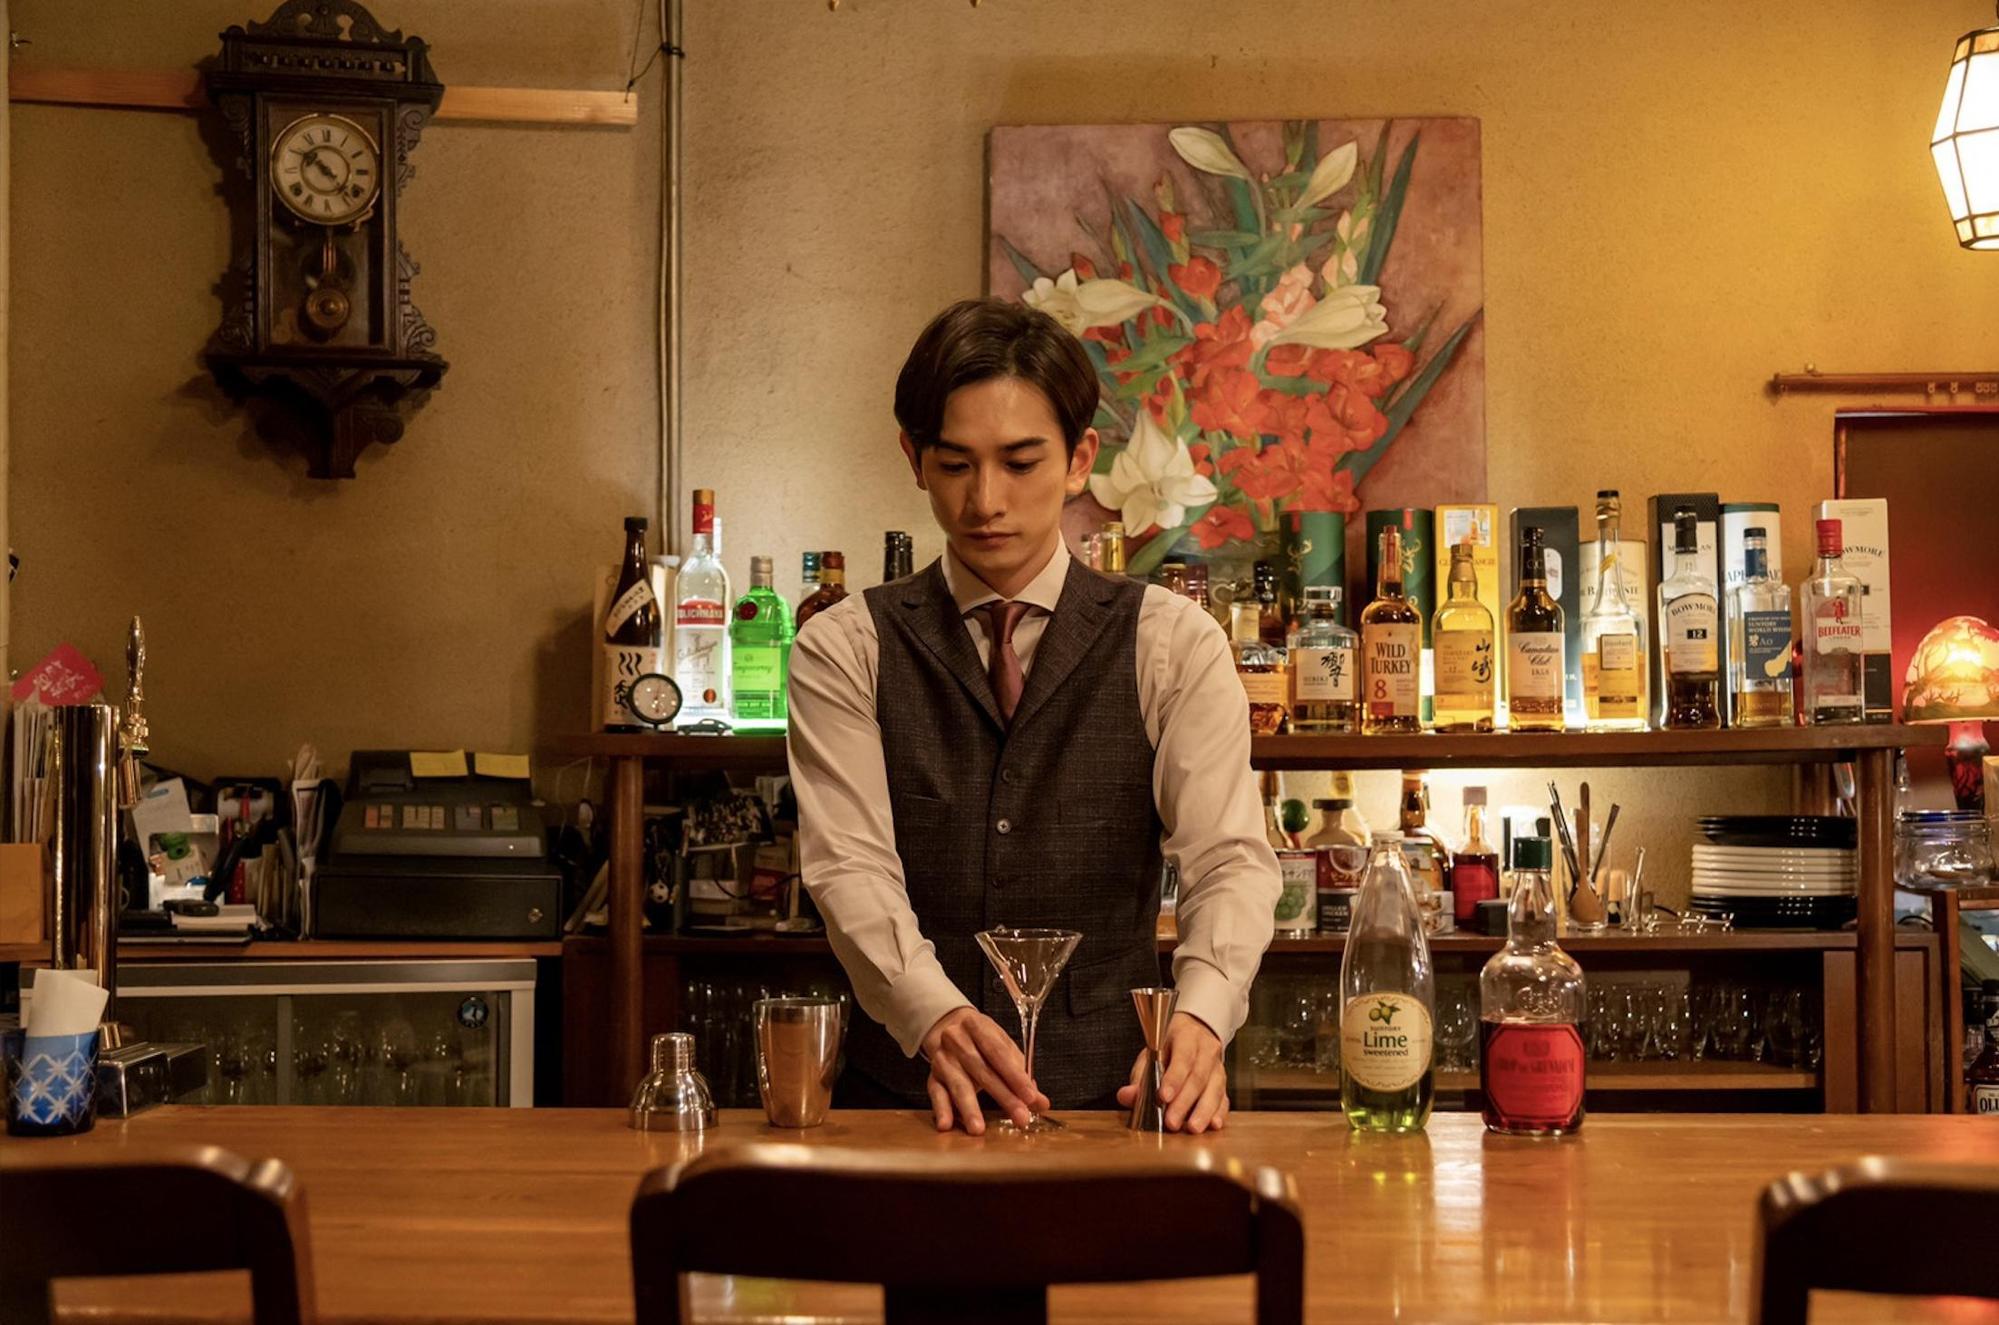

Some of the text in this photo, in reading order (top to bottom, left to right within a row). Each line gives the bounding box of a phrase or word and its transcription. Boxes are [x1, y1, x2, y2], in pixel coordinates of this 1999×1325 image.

[1818, 626, 1861, 638] BEEFEATER
[1376, 642, 1406, 658] WILD
[1370, 657, 1411, 675] TURKEY
[1374, 679, 1386, 700] 8
[1363, 1031, 1408, 1048] Lime
[1363, 1048, 1409, 1057] sweetened
